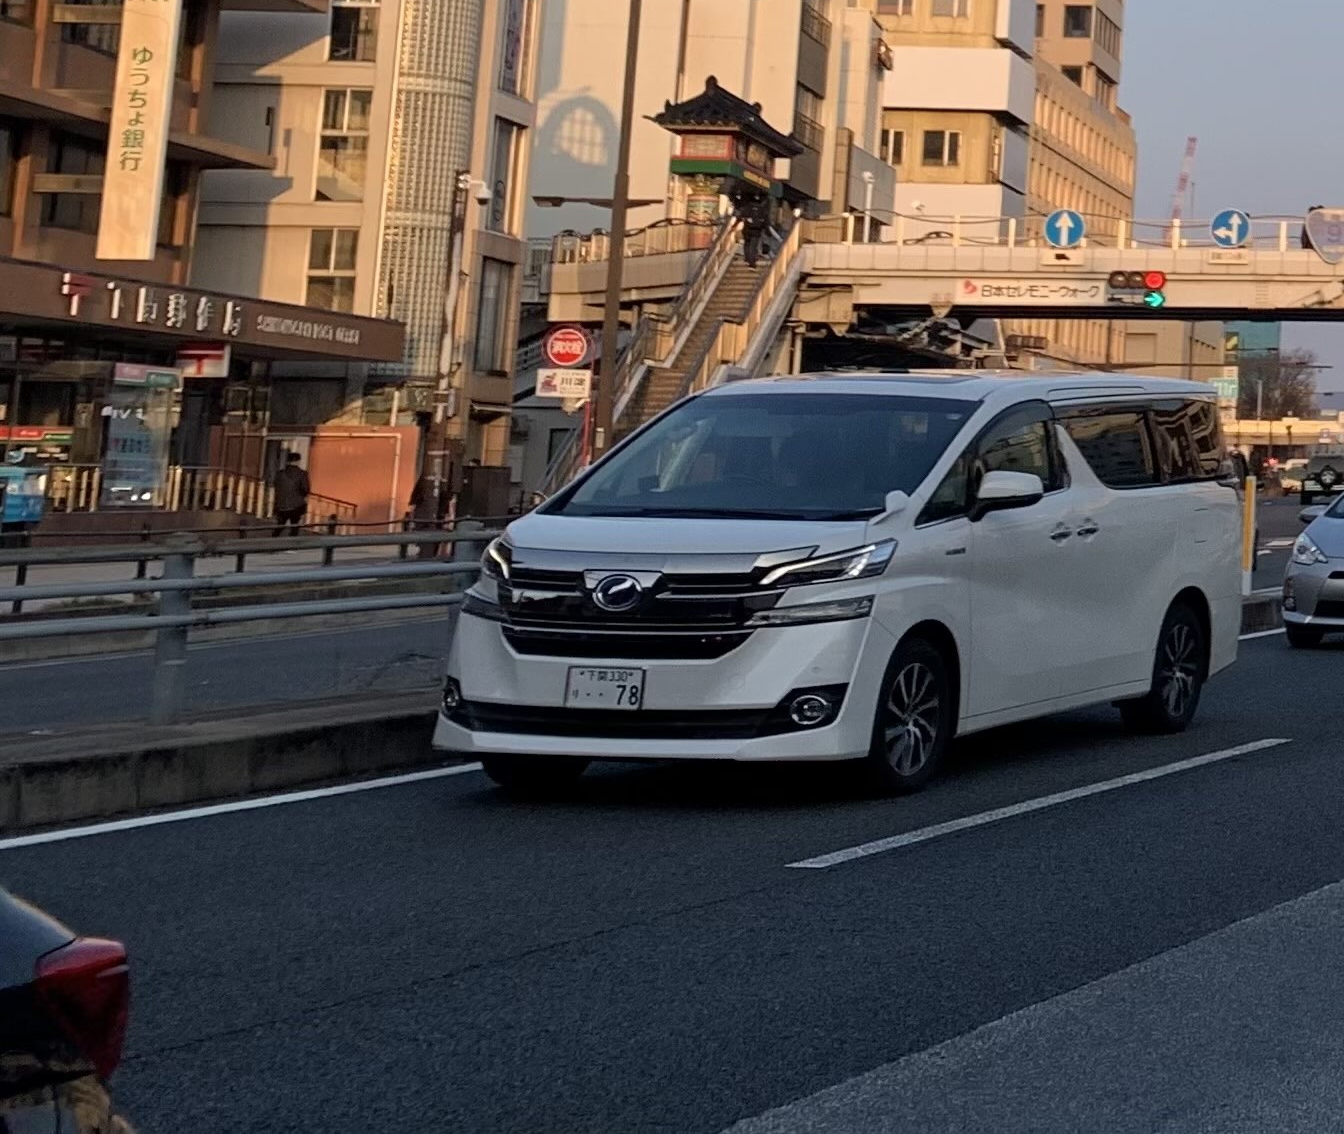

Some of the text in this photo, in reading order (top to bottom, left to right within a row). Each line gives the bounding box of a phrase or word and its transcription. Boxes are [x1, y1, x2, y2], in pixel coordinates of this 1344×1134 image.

[119, 45, 153, 172] ゆうちょ銀行
[1327, 224, 1342, 244] 9
[981, 284, 1100, 299] 日本セレモニーウォーク
